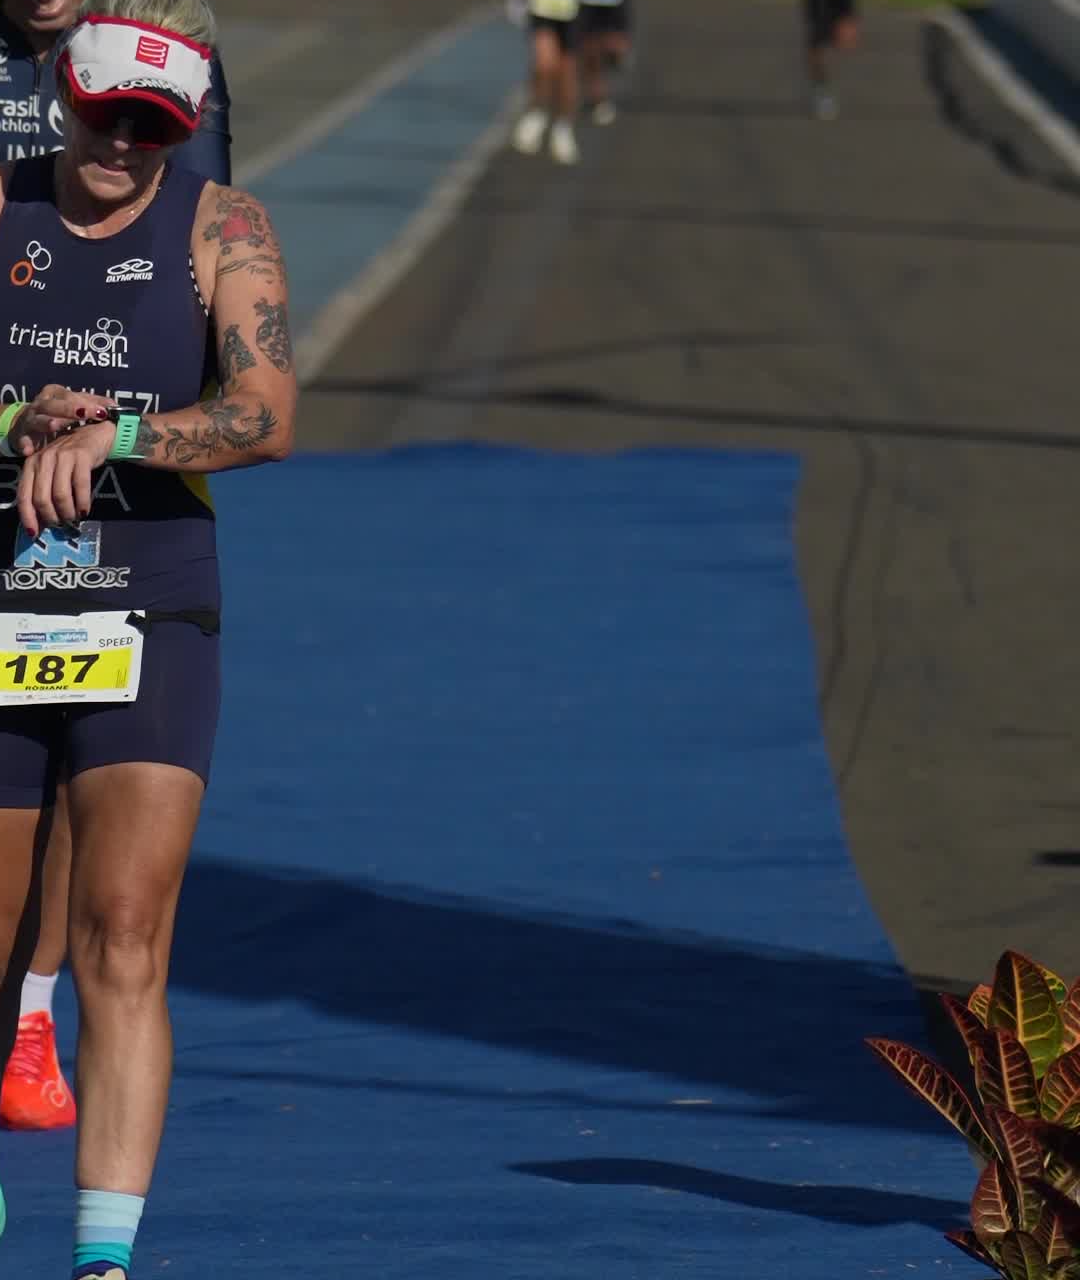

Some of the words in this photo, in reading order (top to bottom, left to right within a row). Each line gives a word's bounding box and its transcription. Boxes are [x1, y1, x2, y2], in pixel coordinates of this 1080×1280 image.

[29, 279, 46, 290] ITU
[105, 272, 153, 283] OLYMPIKUS
[9, 322, 128, 353] triathlon
[53, 349, 129, 368] BRASIL
[98, 636, 134, 648] SPEED
[5, 653, 100, 685] 187
